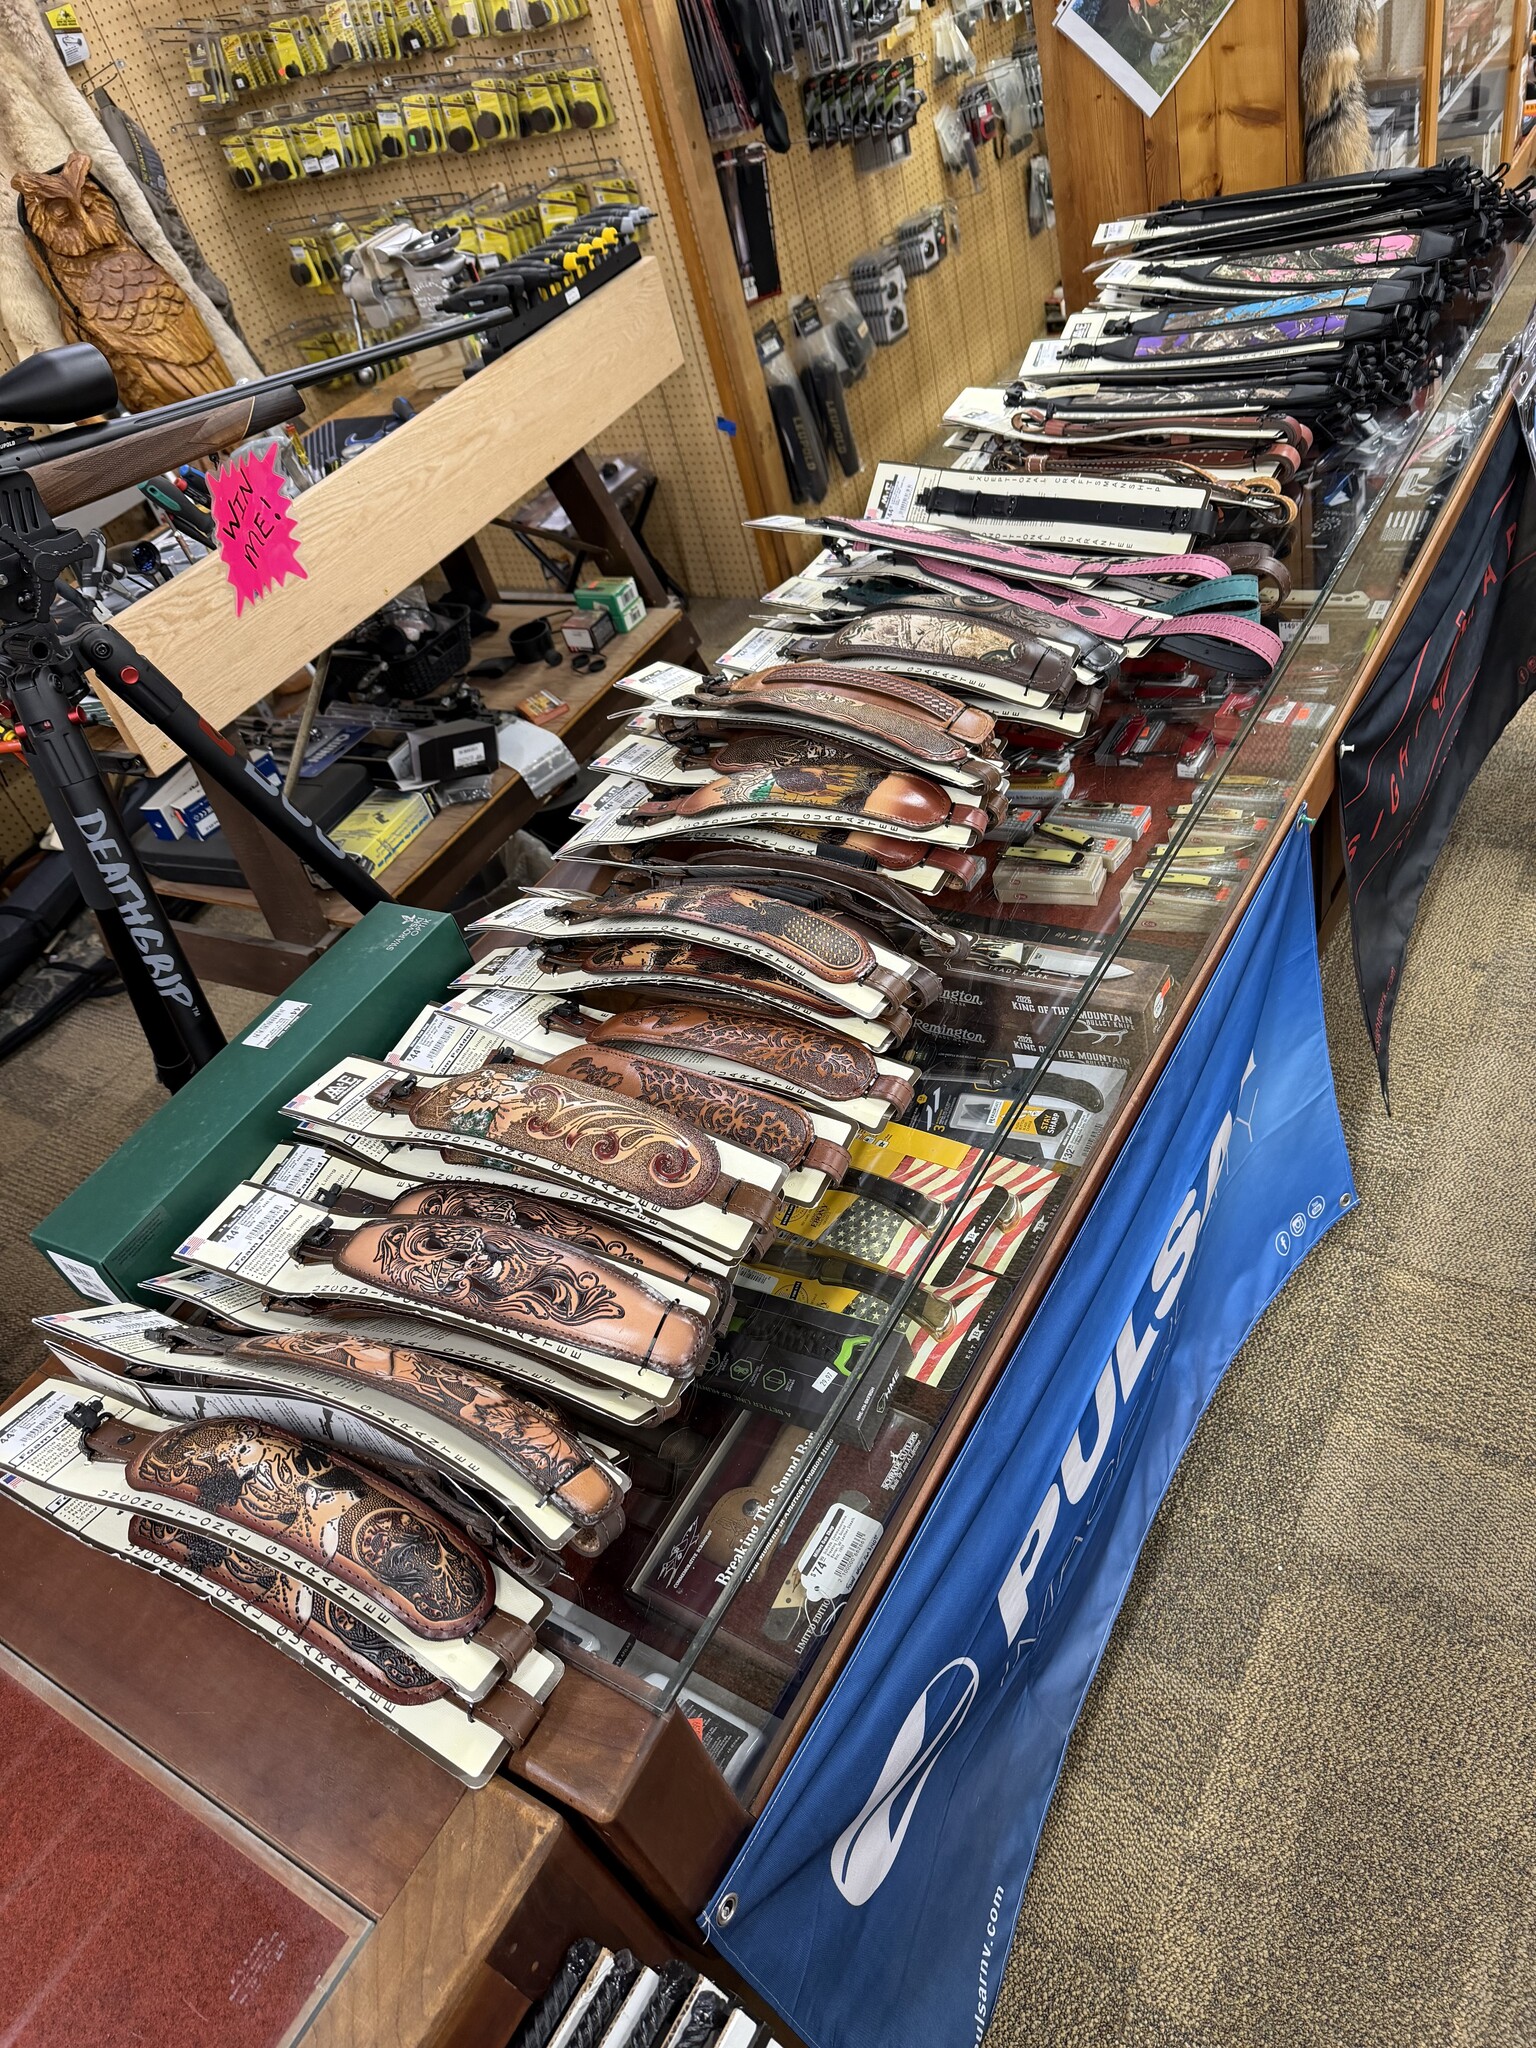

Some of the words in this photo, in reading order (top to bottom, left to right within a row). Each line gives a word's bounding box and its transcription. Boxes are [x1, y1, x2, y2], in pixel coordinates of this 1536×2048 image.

[969, 475, 1047, 483] EXCEPTIONAL
[1054, 476, 1162, 492] CRAFTSMANSHIP
[223, 469, 255, 541] WIN
[243, 497, 282, 570] ME!
[981, 532, 1050, 541] ONDITIONAL
[1059, 535, 1134, 549] GUARANTEE
[907, 666, 986, 687] GUARANTEE
[802, 813, 899, 832] GUARANTEE
[74, 808, 194, 1008] DEATHGRIP
[386, 916, 425, 951] SWAROVSKI
[411, 918, 432, 937] OPTIK
[712, 935, 808, 977] GUARANTEE
[942, 988, 984, 1005] ngton
[1012, 1001, 1035, 1013] KING
[1079, 1009, 1133, 1025] MOUNTAIN
[913, 1018, 986, 1043] Remington
[1013, 1041, 1037, 1052] KING
[1077, 1052, 1131, 1067] MOUNTAIN
[325, 1075, 359, 1100] M&E
[707, 1070, 807, 1096] GUARANTEE
[1041, 1114, 1051, 1131] STAY
[1047, 1113, 1060, 1134] SHARP
[295, 1161, 323, 1195] Padded
[405, 1131, 539, 1161] UNCONDITIONAL
[552, 1161, 661, 1214] GUARANTEE
[810, 1203, 828, 1228] EBONY
[978, 1214, 992, 1231] 1902
[1047, 1203, 1060, 1220] 1902
[234, 1241, 259, 1267] Foam
[258, 1209, 289, 1241] Padded
[982, 1310, 996, 1327] 1902
[442, 1346, 556, 1384] GUARANTEE
[820, 1371, 833, 1387] 29.97
[184, 1363, 346, 1400] UNCONDITIONAL
[361, 1402, 481, 1472] GUARANTEE
[18, 1435, 51, 1460] Foam
[45, 1457, 63, 1473] Easy
[784, 1484, 806, 1519] American
[804, 1456, 823, 1485] Aviation
[820, 1437, 834, 1459] Histo
[715, 1525, 759, 1586] Breaking
[754, 1497, 776, 1527] The
[771, 1455, 801, 1497] Sound
[98, 1489, 250, 1542] UNCONDITIONAL
[265, 1544, 391, 1624] GUARANTEE
[125, 1542, 264, 1620] UNCONDITIONAL
[277, 1624, 397, 1713] GUARANTEE
[794, 1623, 817, 1654] LIMITED
[814, 1599, 831, 1626] EDITIO
